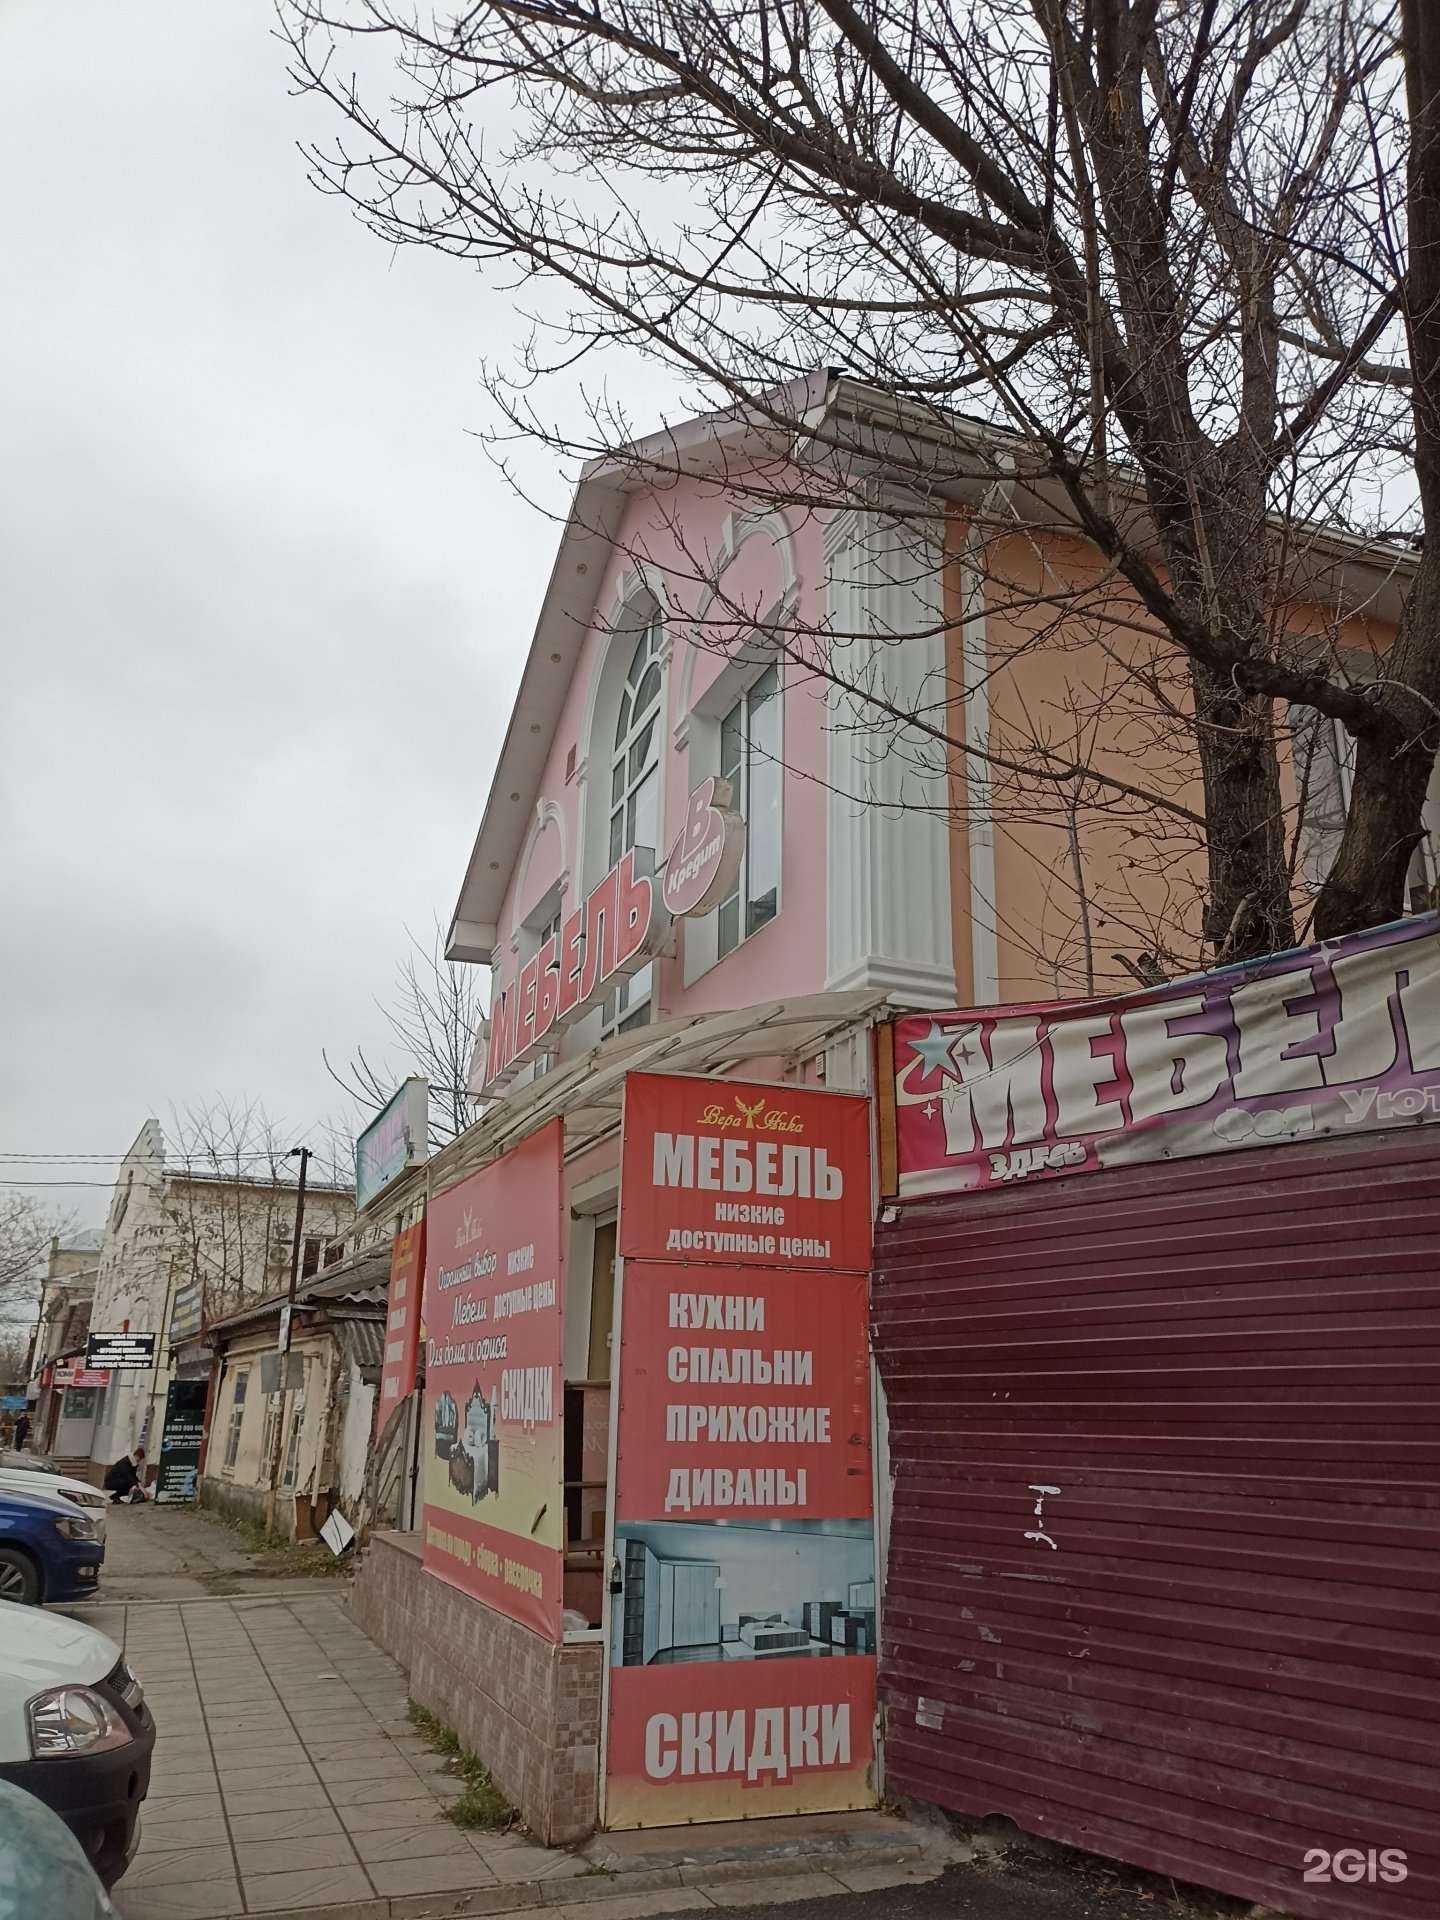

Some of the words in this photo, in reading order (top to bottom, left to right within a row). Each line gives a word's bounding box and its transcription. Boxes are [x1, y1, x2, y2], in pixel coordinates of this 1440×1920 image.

[668, 835, 721, 895] Кредит
[486, 846, 654, 1088] МЕБЕЛЬ
[697, 1104, 743, 1132] Вера
[756, 1110, 805, 1135] Ника
[652, 1132, 844, 1201] МЕБЕЛЬ
[715, 1202, 785, 1226] низкие
[507, 1243, 535, 1276] низкие
[666, 1228, 776, 1255] доступные
[779, 1236, 831, 1260] цены
[451, 1291, 488, 1330] Мебели
[493, 1286, 533, 1322] доступные
[533, 1279, 556, 1312] цены
[668, 1292, 766, 1332] КУХНИ
[428, 1337, 443, 1368] Для
[444, 1336, 466, 1365] дома
[468, 1341, 475, 1362] и
[476, 1335, 507, 1369] офиса
[666, 1345, 814, 1386] СПАЛЬНИ
[500, 1366, 553, 1422] СКИДКИ
[665, 1403, 833, 1443] ПРИХОЖИЕ
[664, 1467, 808, 1513] ДИВАНЫ
[644, 1703, 852, 1781] СКИДКИ
